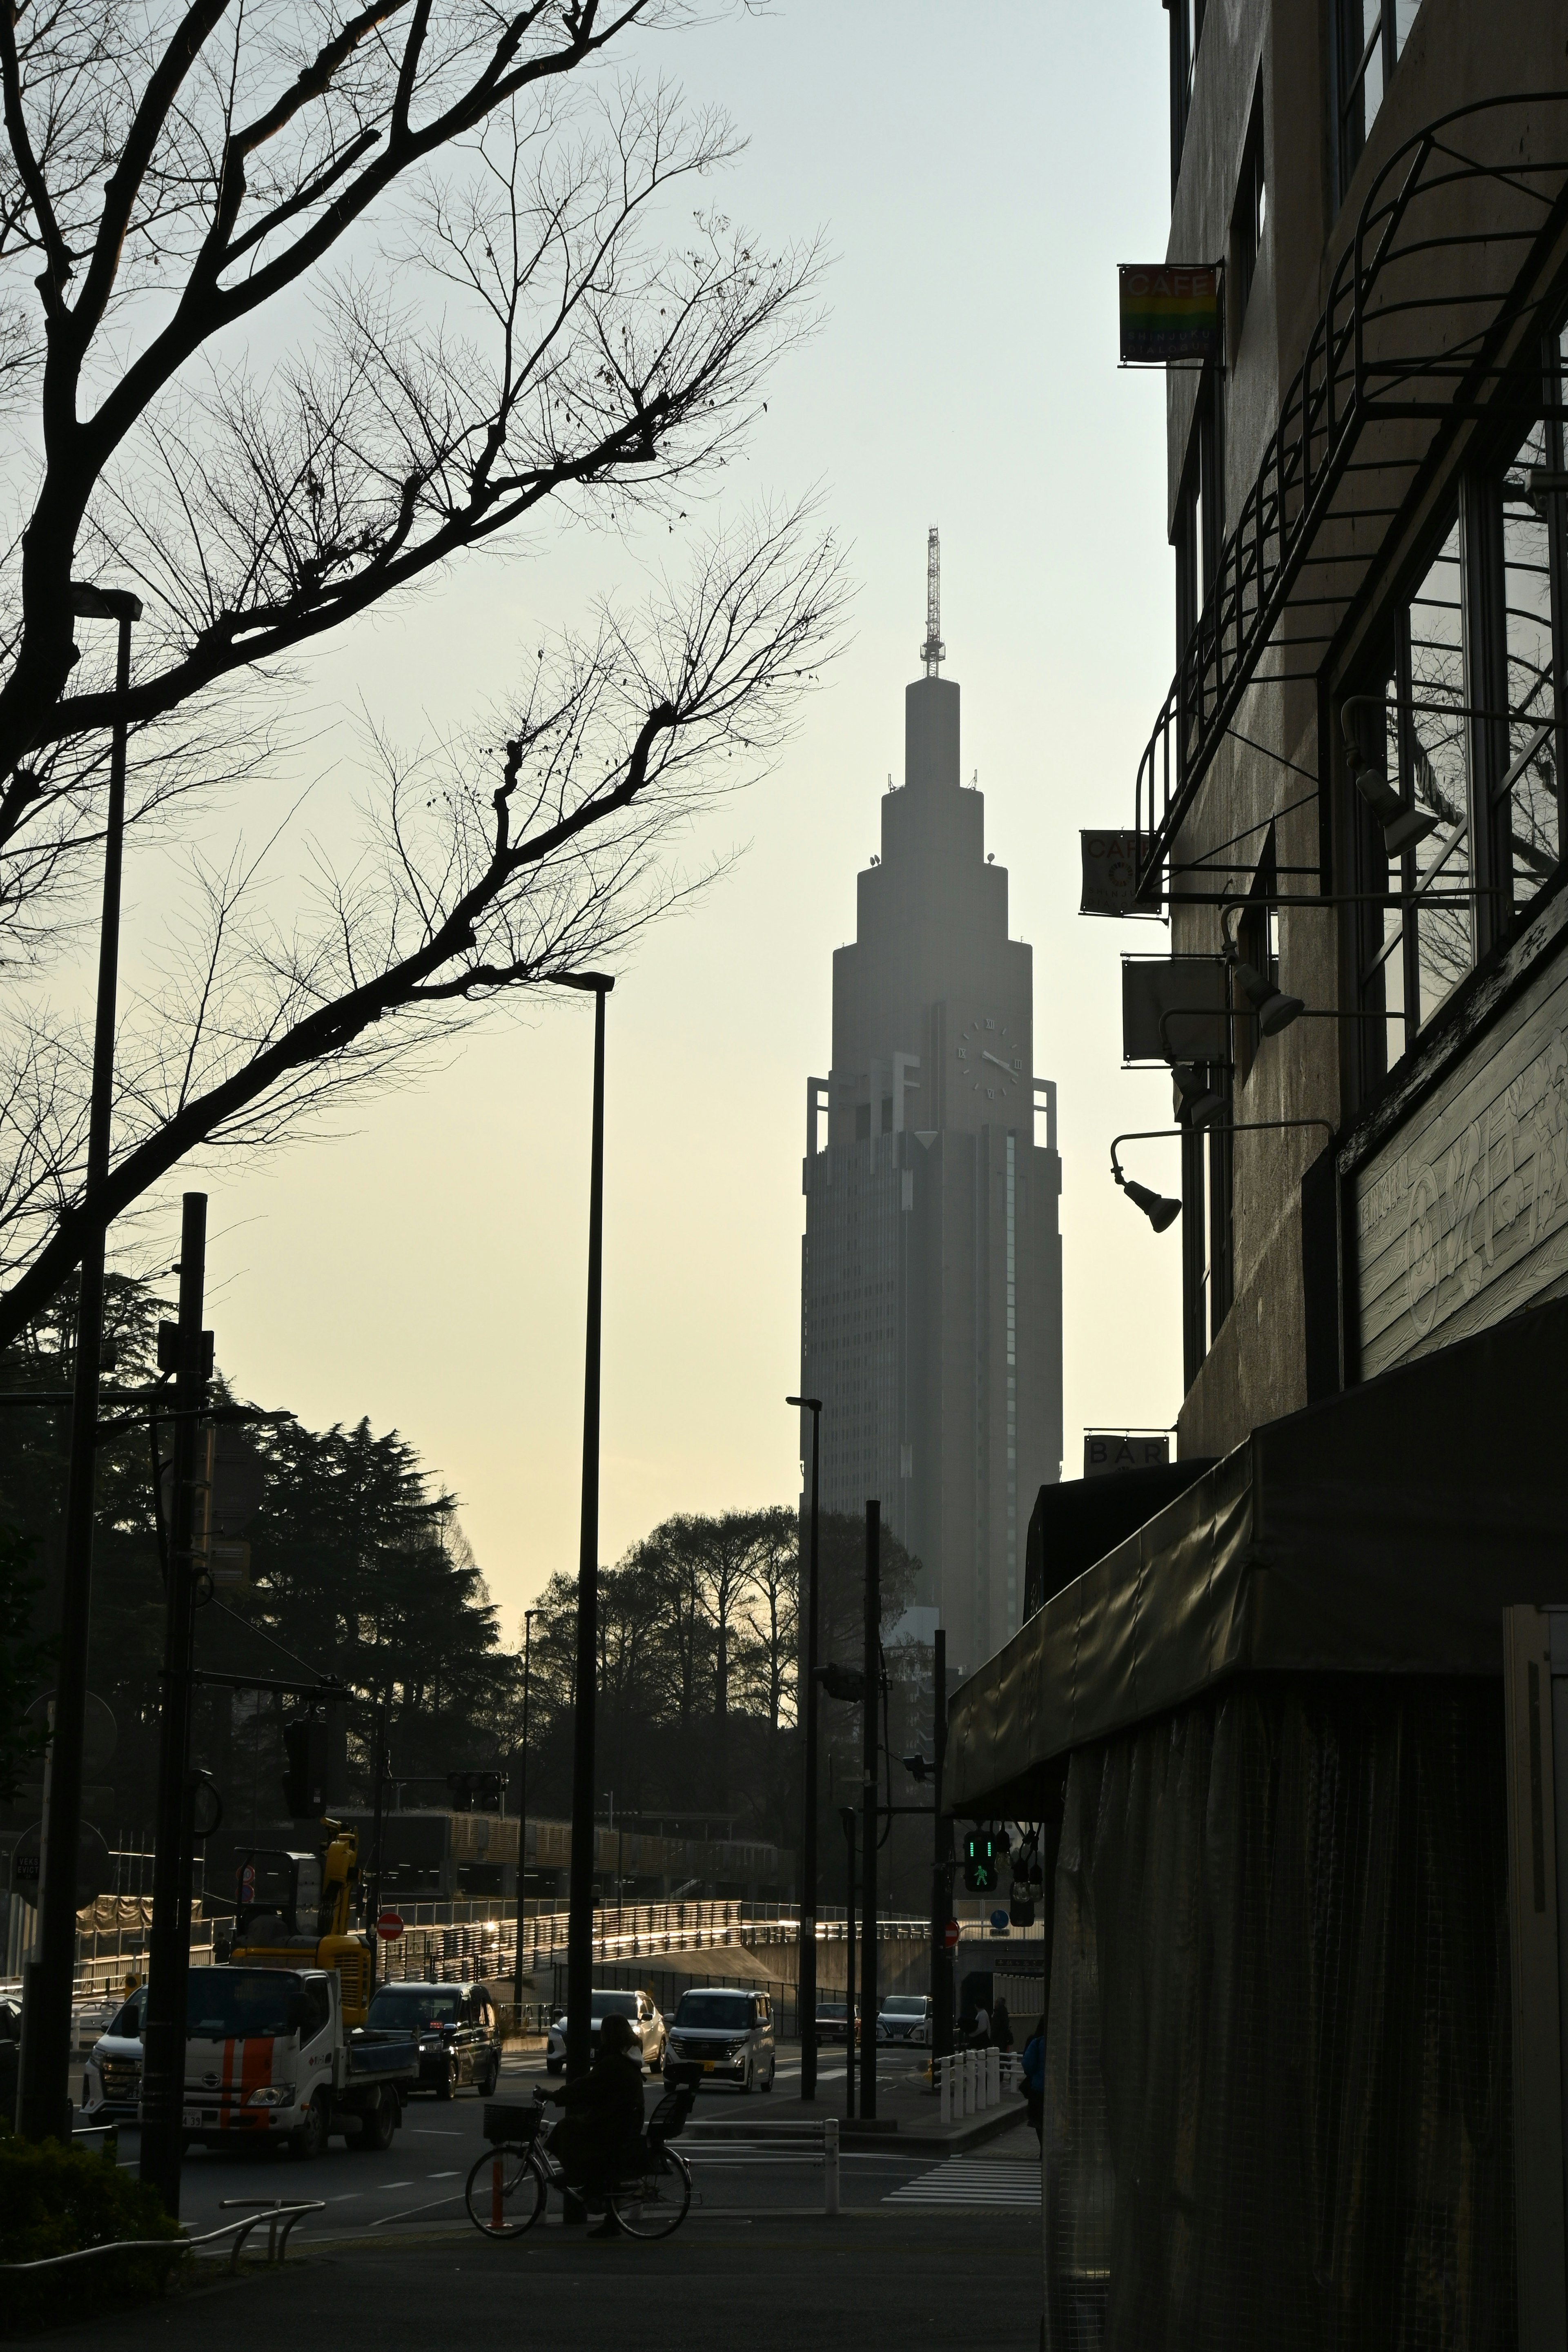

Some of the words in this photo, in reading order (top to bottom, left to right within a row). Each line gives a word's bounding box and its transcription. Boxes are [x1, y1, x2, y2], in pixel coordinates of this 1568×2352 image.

[1128, 274, 1209, 297] CAFE
[1128, 330, 1209, 341] SHINJUKU
[1128, 342, 1209, 354] DIALOGUE
[1088, 887, 1156, 898] SHINJU
[986, 1019, 995, 1030] XII
[958, 1048, 966, 1059] IX
[987, 1089, 994, 1099] VI
[1090, 1442, 1162, 1463] BAR
